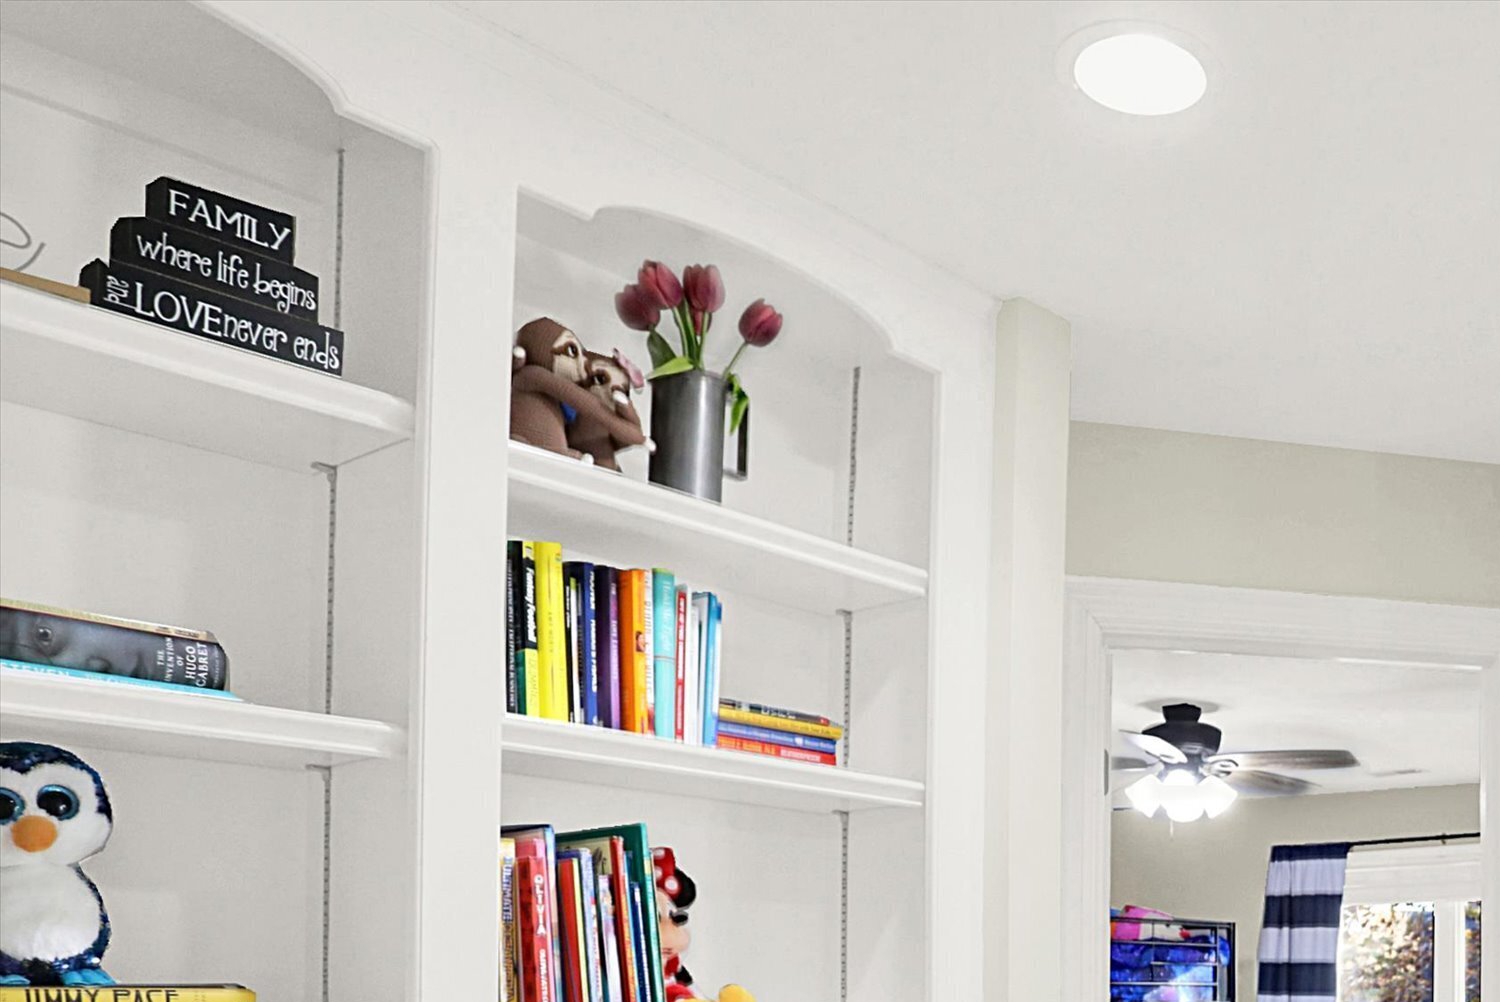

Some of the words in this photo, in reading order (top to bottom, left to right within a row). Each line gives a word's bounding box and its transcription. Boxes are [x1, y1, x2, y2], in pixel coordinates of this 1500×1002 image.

[168, 188, 291, 250] FAMILY
[137, 233, 212, 277] where
[216, 251, 249, 289] life
[253, 263, 316, 313] begins
[103, 275, 137, 308] and
[134, 281, 223, 338] LOVE
[223, 315, 287, 352] never
[293, 332, 340, 370] ends
[525, 567, 535, 604] Fantasy
[527, 603, 537, 643] Football
[164, 637, 174, 683] INVENTION
[185, 645, 196, 679] HUGO
[195, 641, 208, 687] CABRET
[533, 874, 546, 936] OLIVIA
